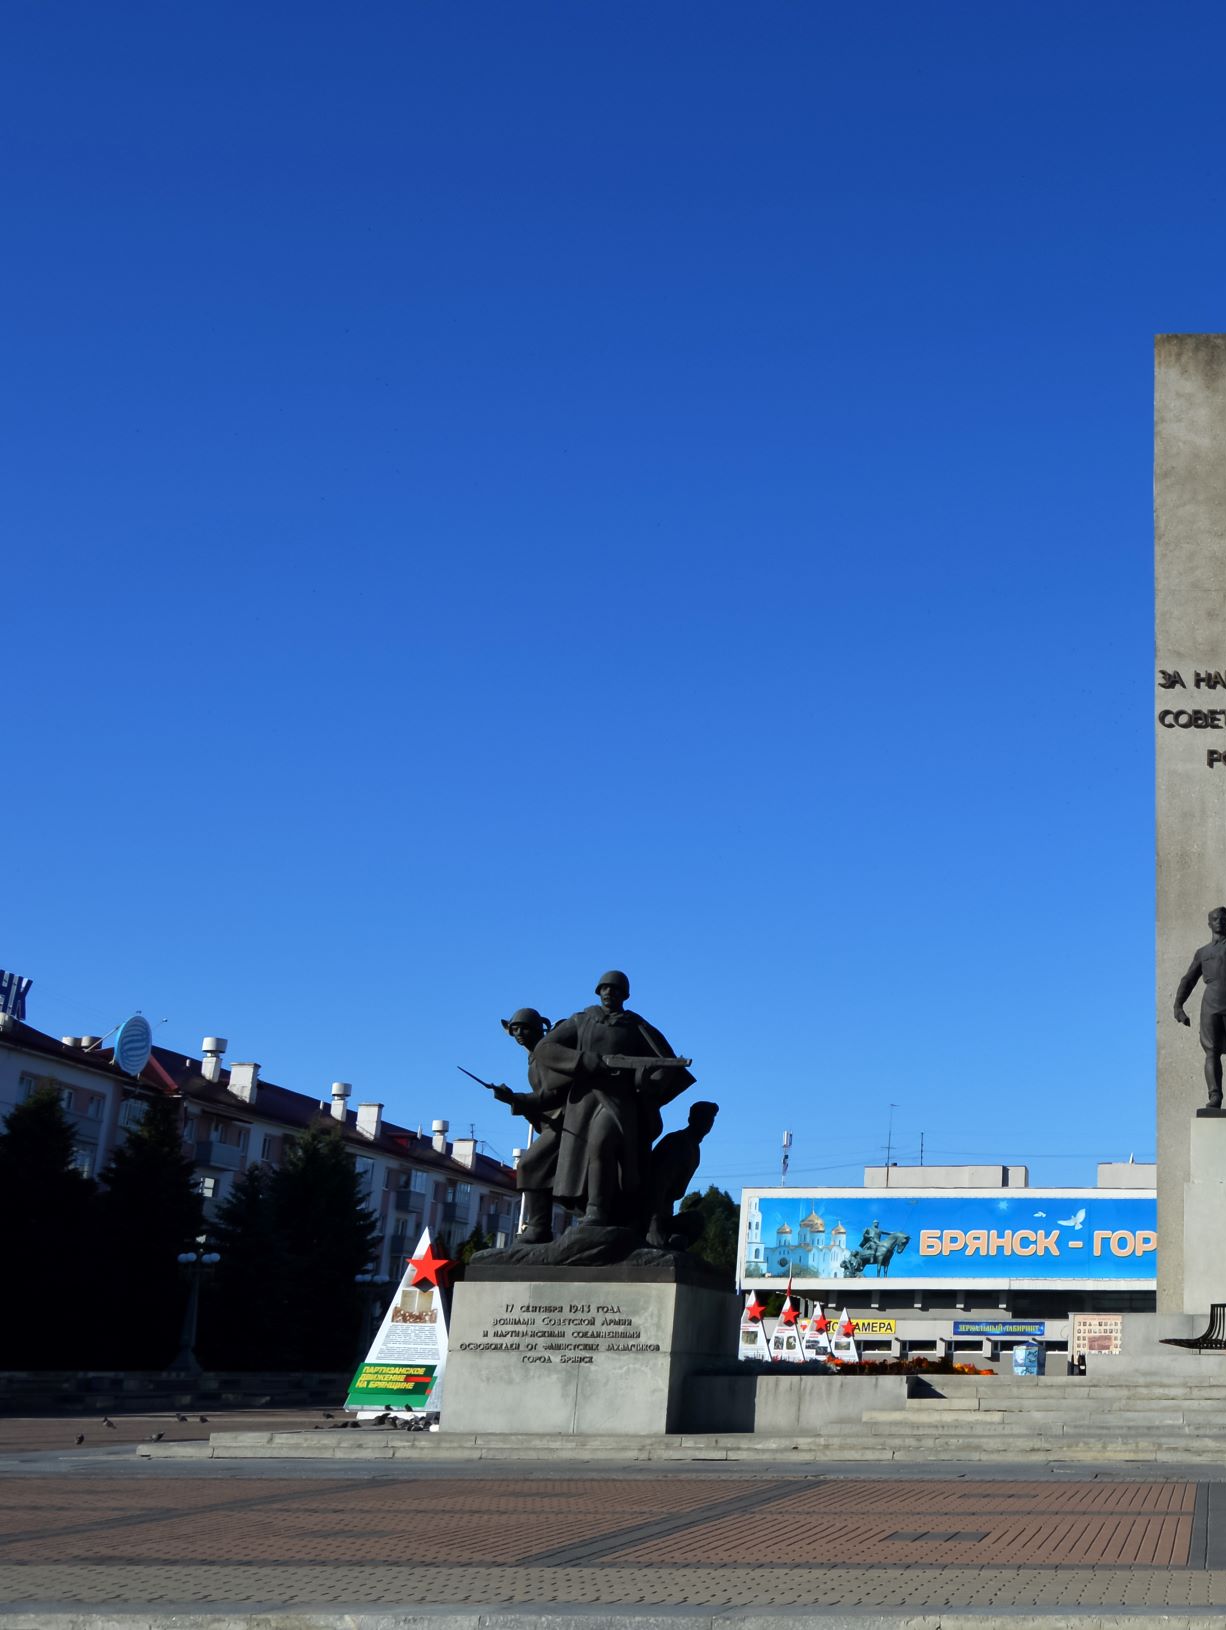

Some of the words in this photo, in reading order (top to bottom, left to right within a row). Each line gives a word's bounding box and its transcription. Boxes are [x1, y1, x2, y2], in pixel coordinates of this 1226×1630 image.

[1158, 669, 1187, 690] ЗА
[919, 1229, 1060, 1256] БРЯНСК
[505, 1304, 515, 1313] 17
[520, 1305, 563, 1313] СЕНТЯБРЯ
[569, 1304, 592, 1313] 1943
[597, 1305, 622, 1313] ГОДА
[492, 1318, 536, 1326] ВОИНАМИ
[542, 1316, 596, 1326] СОВЕТСКОЙ
[601, 1317, 632, 1326] АРМИИ
[482, 1330, 489, 1338] И
[493, 1330, 566, 1338] ПАРТИЗАНСКИМИ
[571, 1330, 641, 1338] СОЕДИНЕНИЯМИ
[460, 1342, 520, 1351] ОСВОБОЖДЕН
[526, 1343, 538, 1351] ОТ
[543, 1343, 600, 1351] ФАШИСТСКИХ
[606, 1343, 660, 1352] ЗАХВАТЧИКОВ
[522, 1355, 552, 1364] ГОРОД
[560, 1354, 594, 1364] БРЯНСК
[363, 1366, 426, 1375] ПАРТИЗАНСКОЕ
[359, 1374, 406, 1382] ДВИЖЕНИЕ
[368, 1381, 415, 1390] БРЯНЩИНЕ
